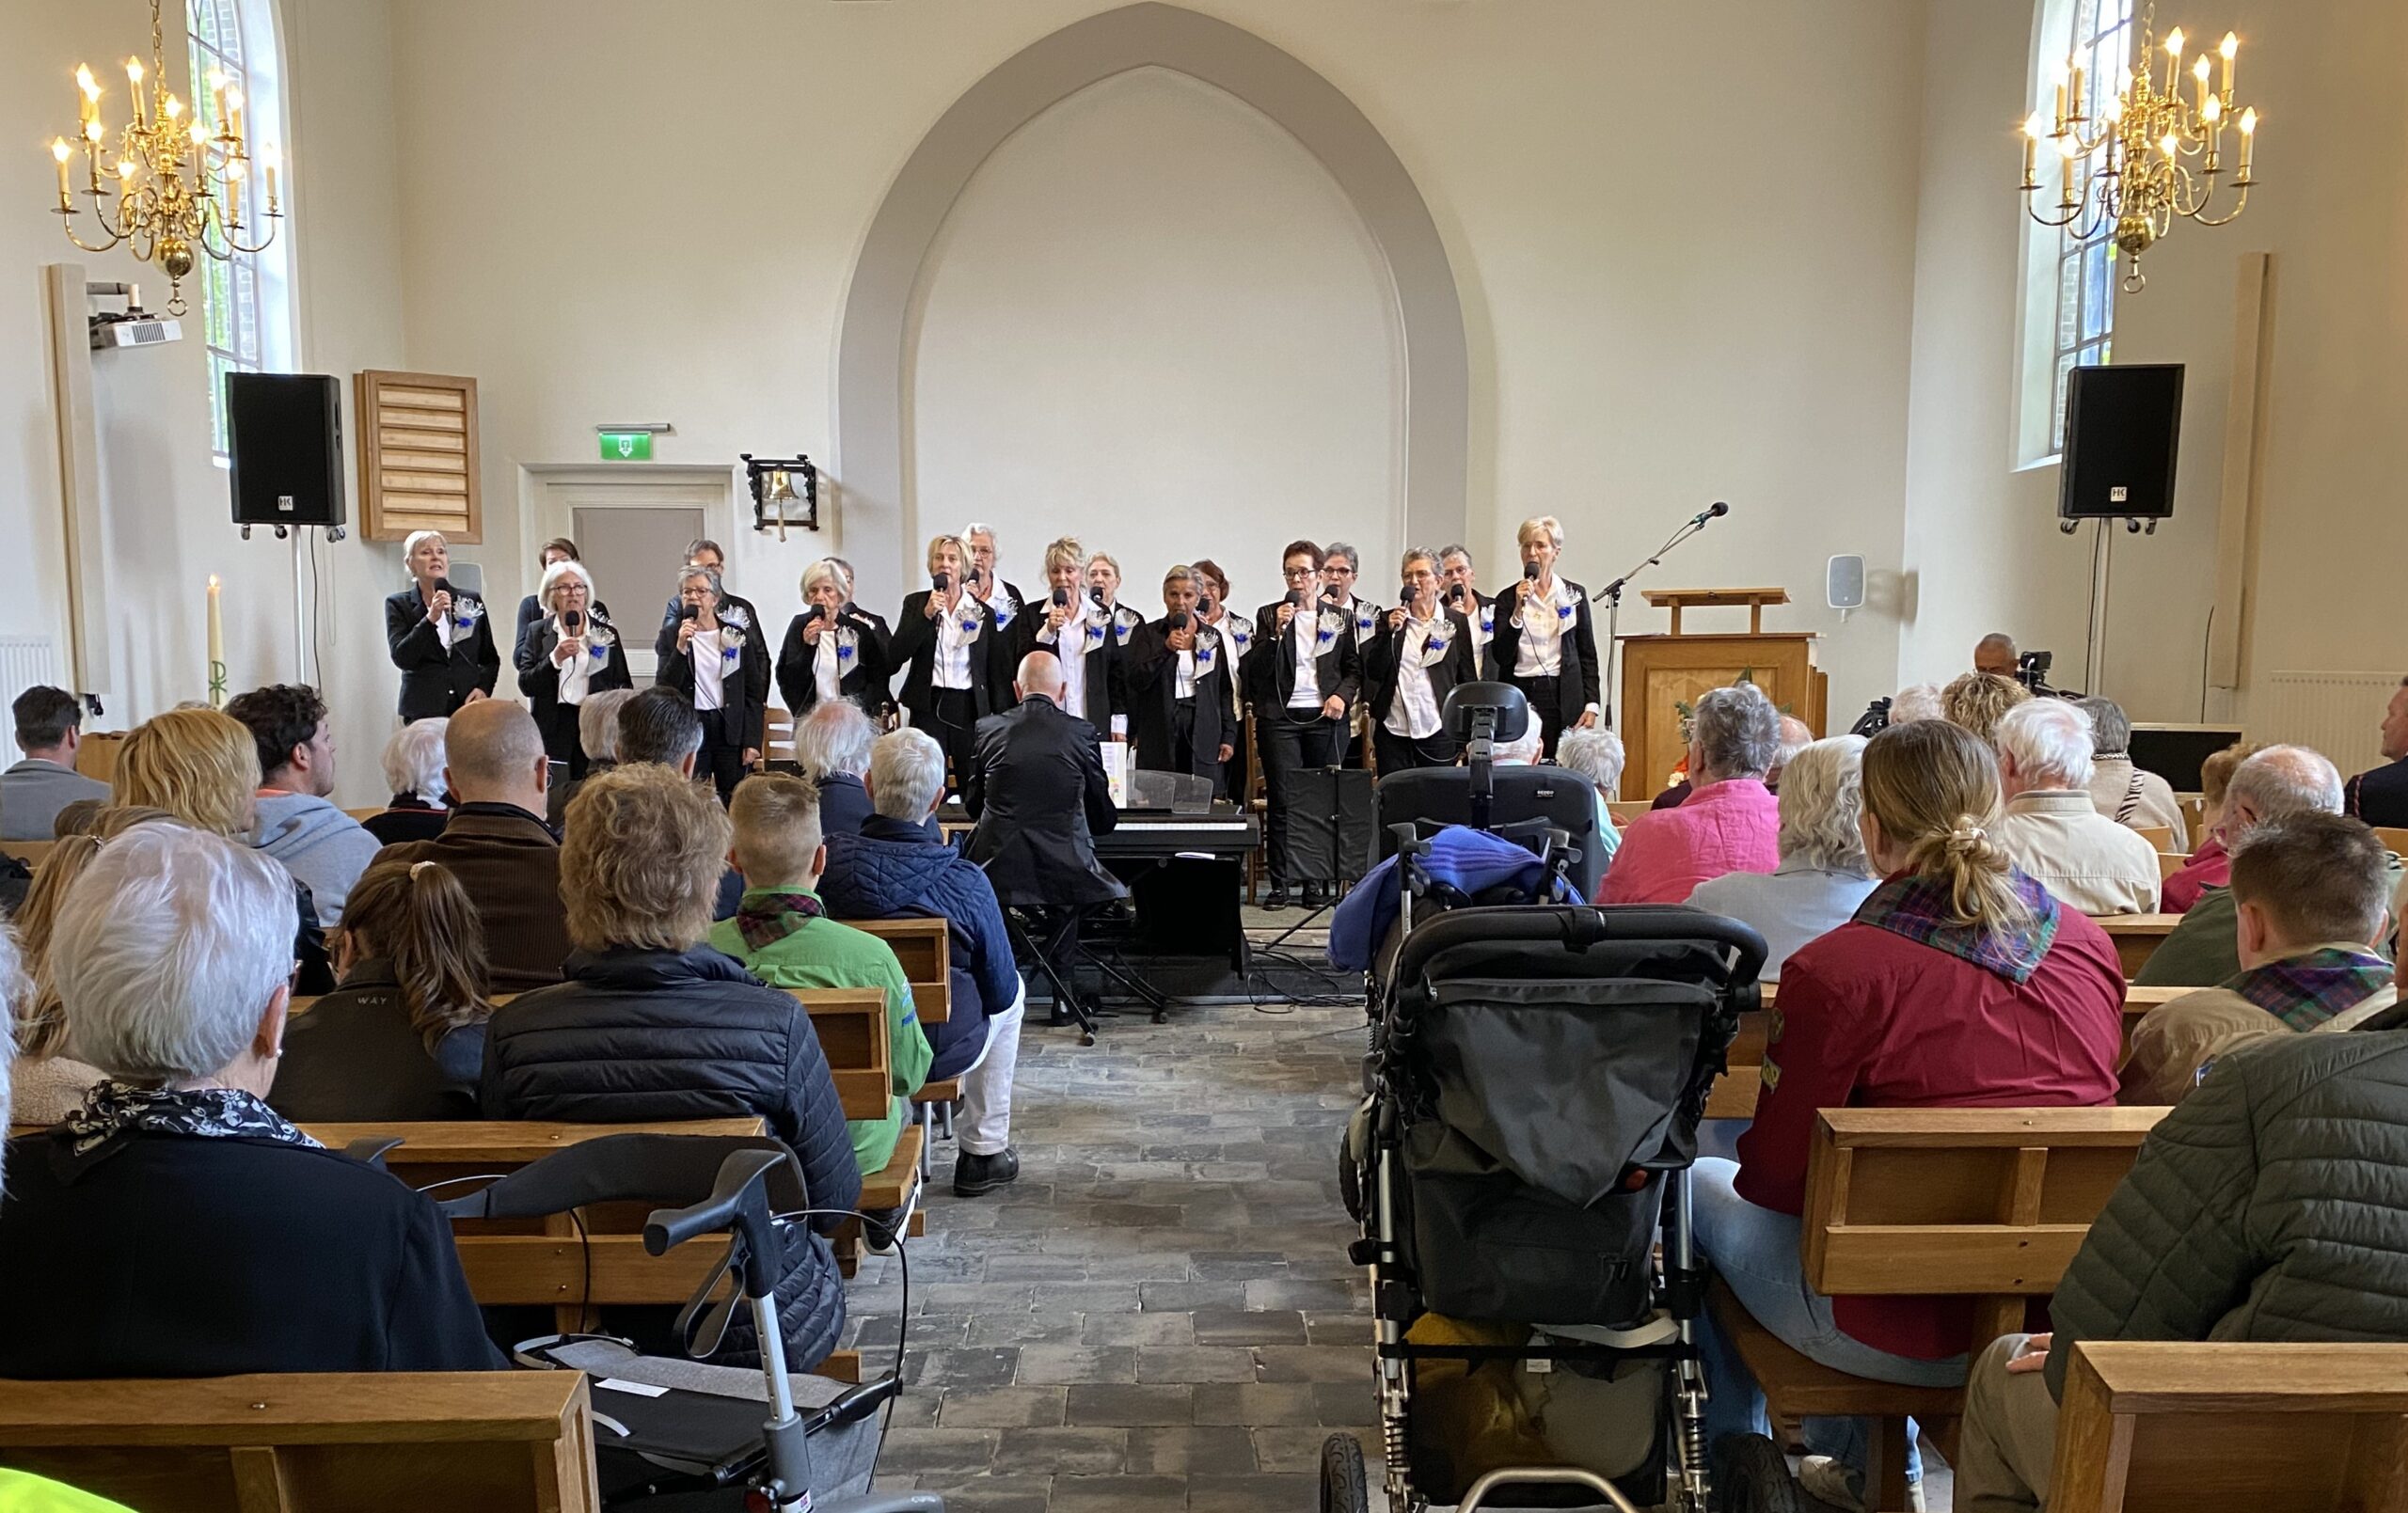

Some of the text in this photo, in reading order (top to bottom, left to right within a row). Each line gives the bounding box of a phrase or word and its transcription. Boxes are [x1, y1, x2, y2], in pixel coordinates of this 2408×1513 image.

[2112, 488, 2125, 497] HK
[278, 497, 292, 506] HK
[357, 997, 388, 1005] WAY
